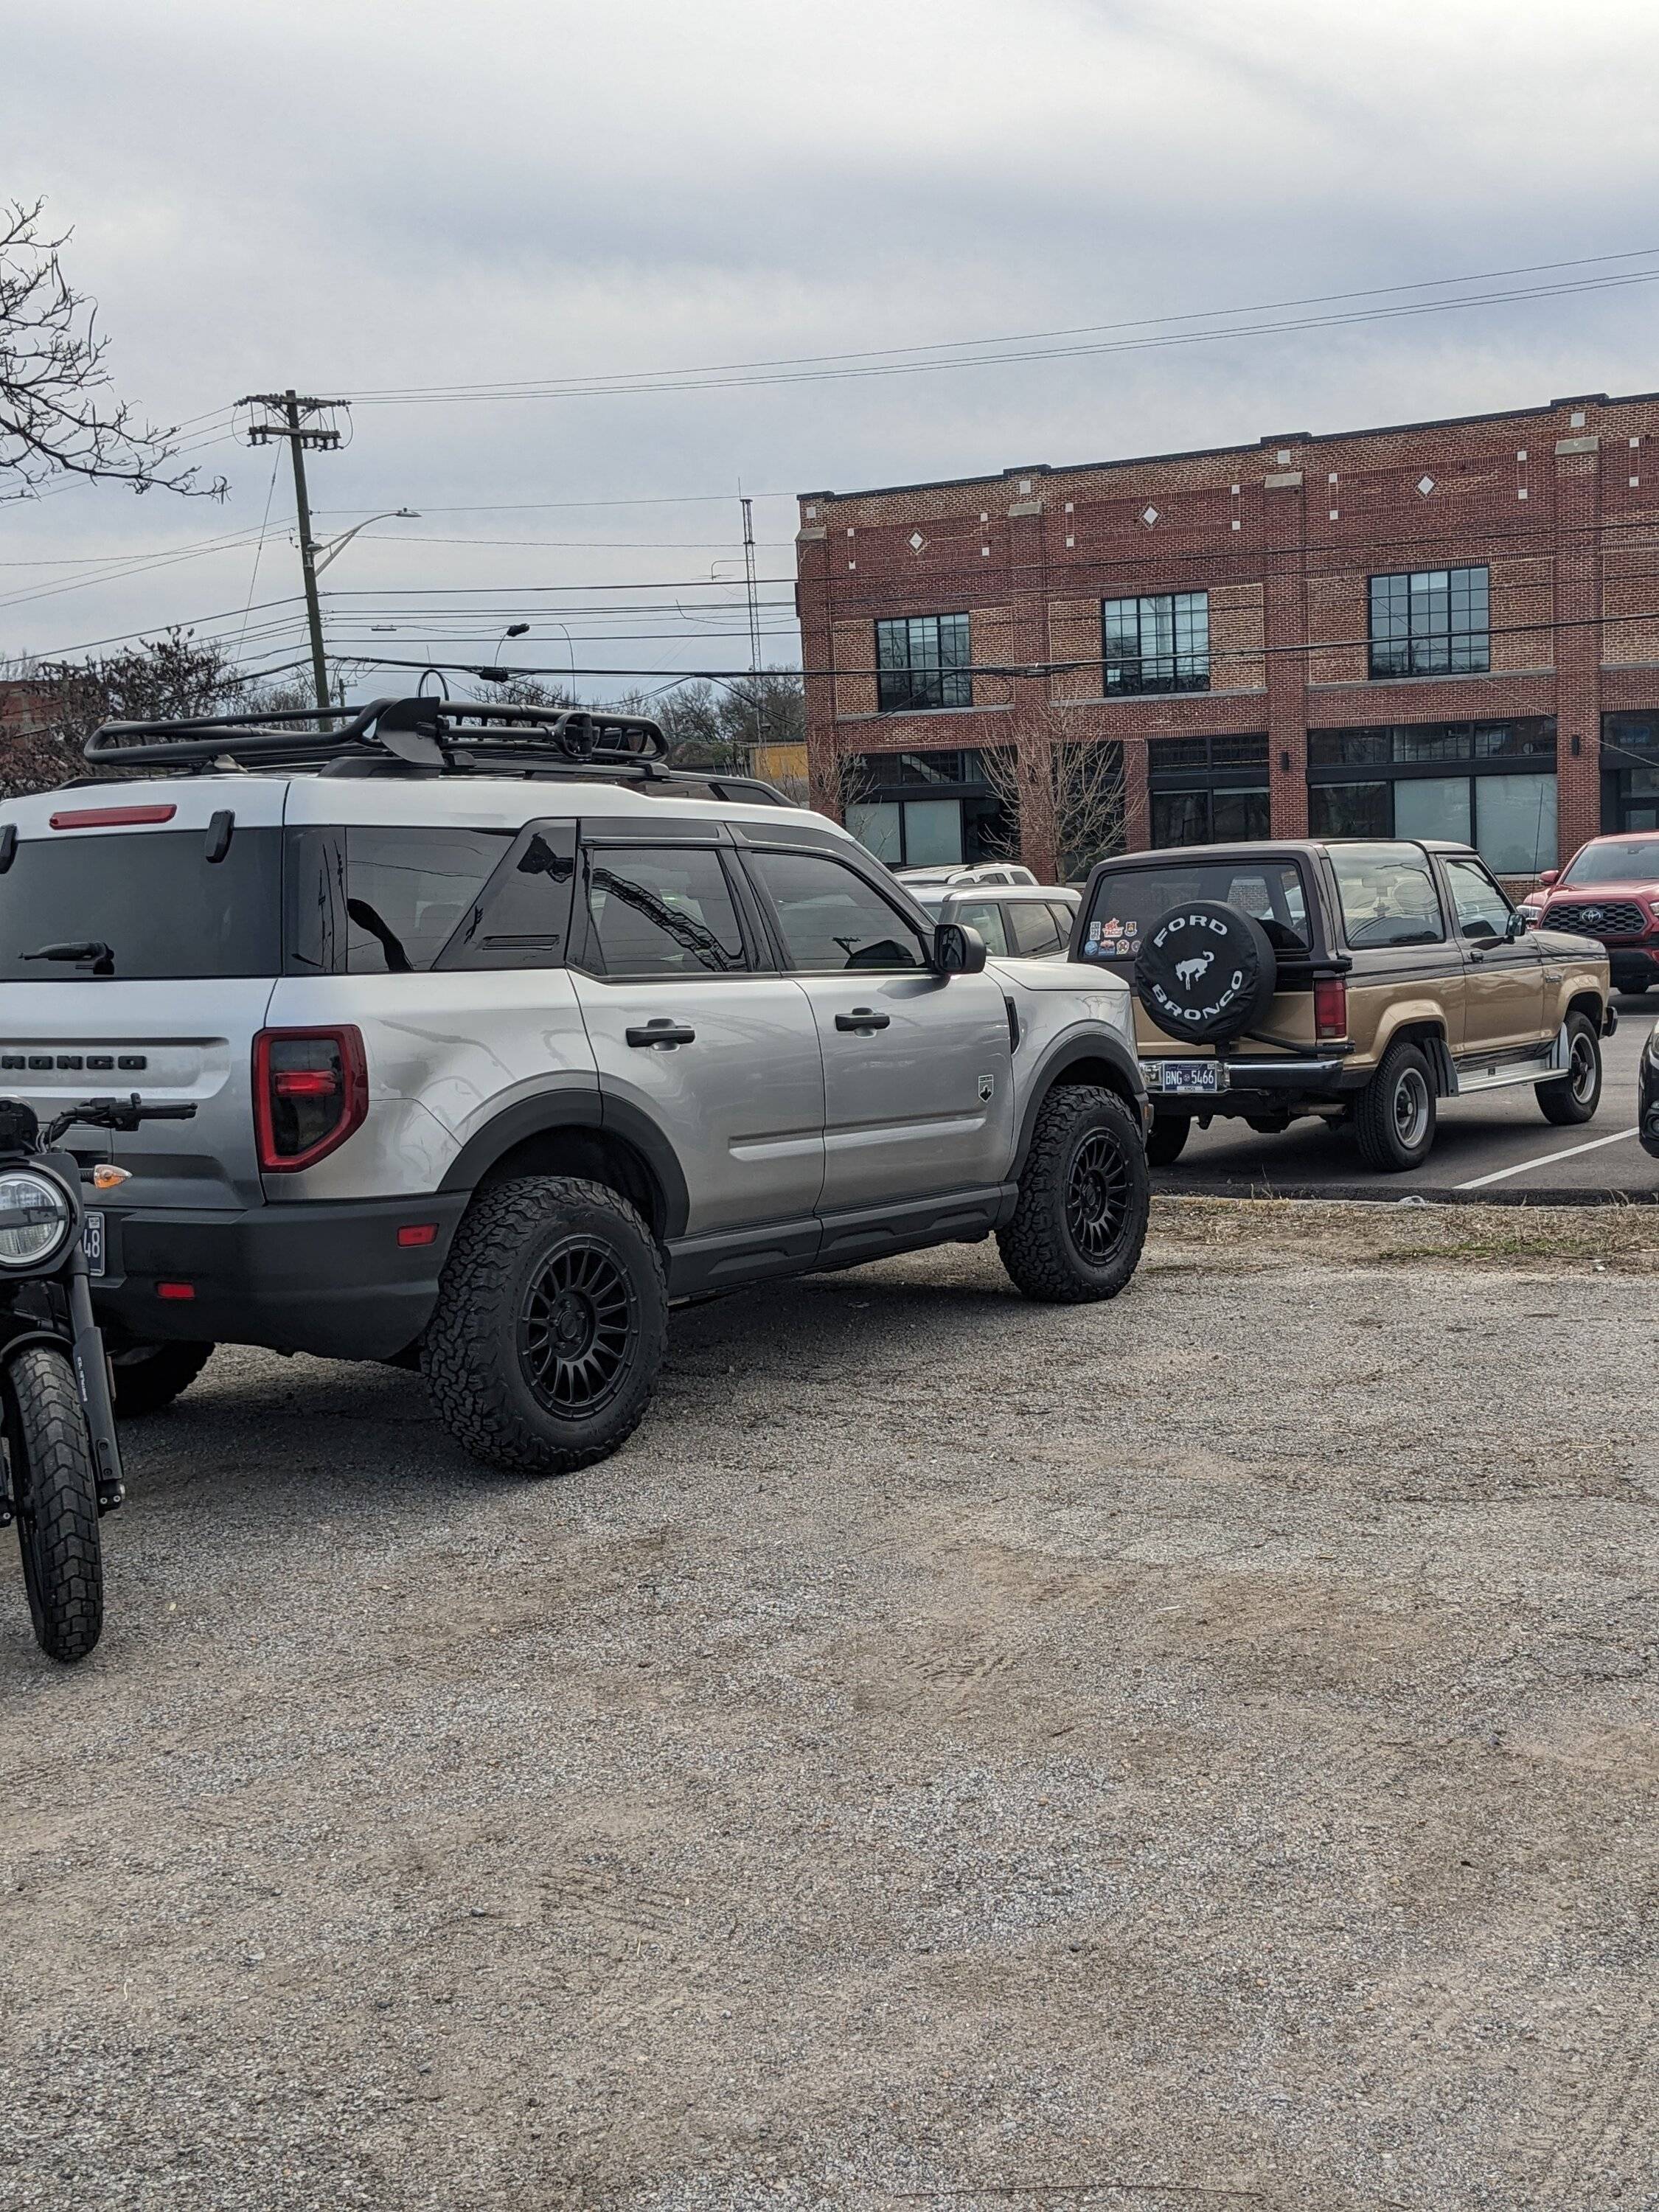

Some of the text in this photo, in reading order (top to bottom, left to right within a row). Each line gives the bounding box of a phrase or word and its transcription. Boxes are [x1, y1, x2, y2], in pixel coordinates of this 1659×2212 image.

[1153, 914, 1228, 947] FORD
[1152, 970, 1242, 1020] BRONCO
[1165, 1070, 1214, 1085] BNG 5466
